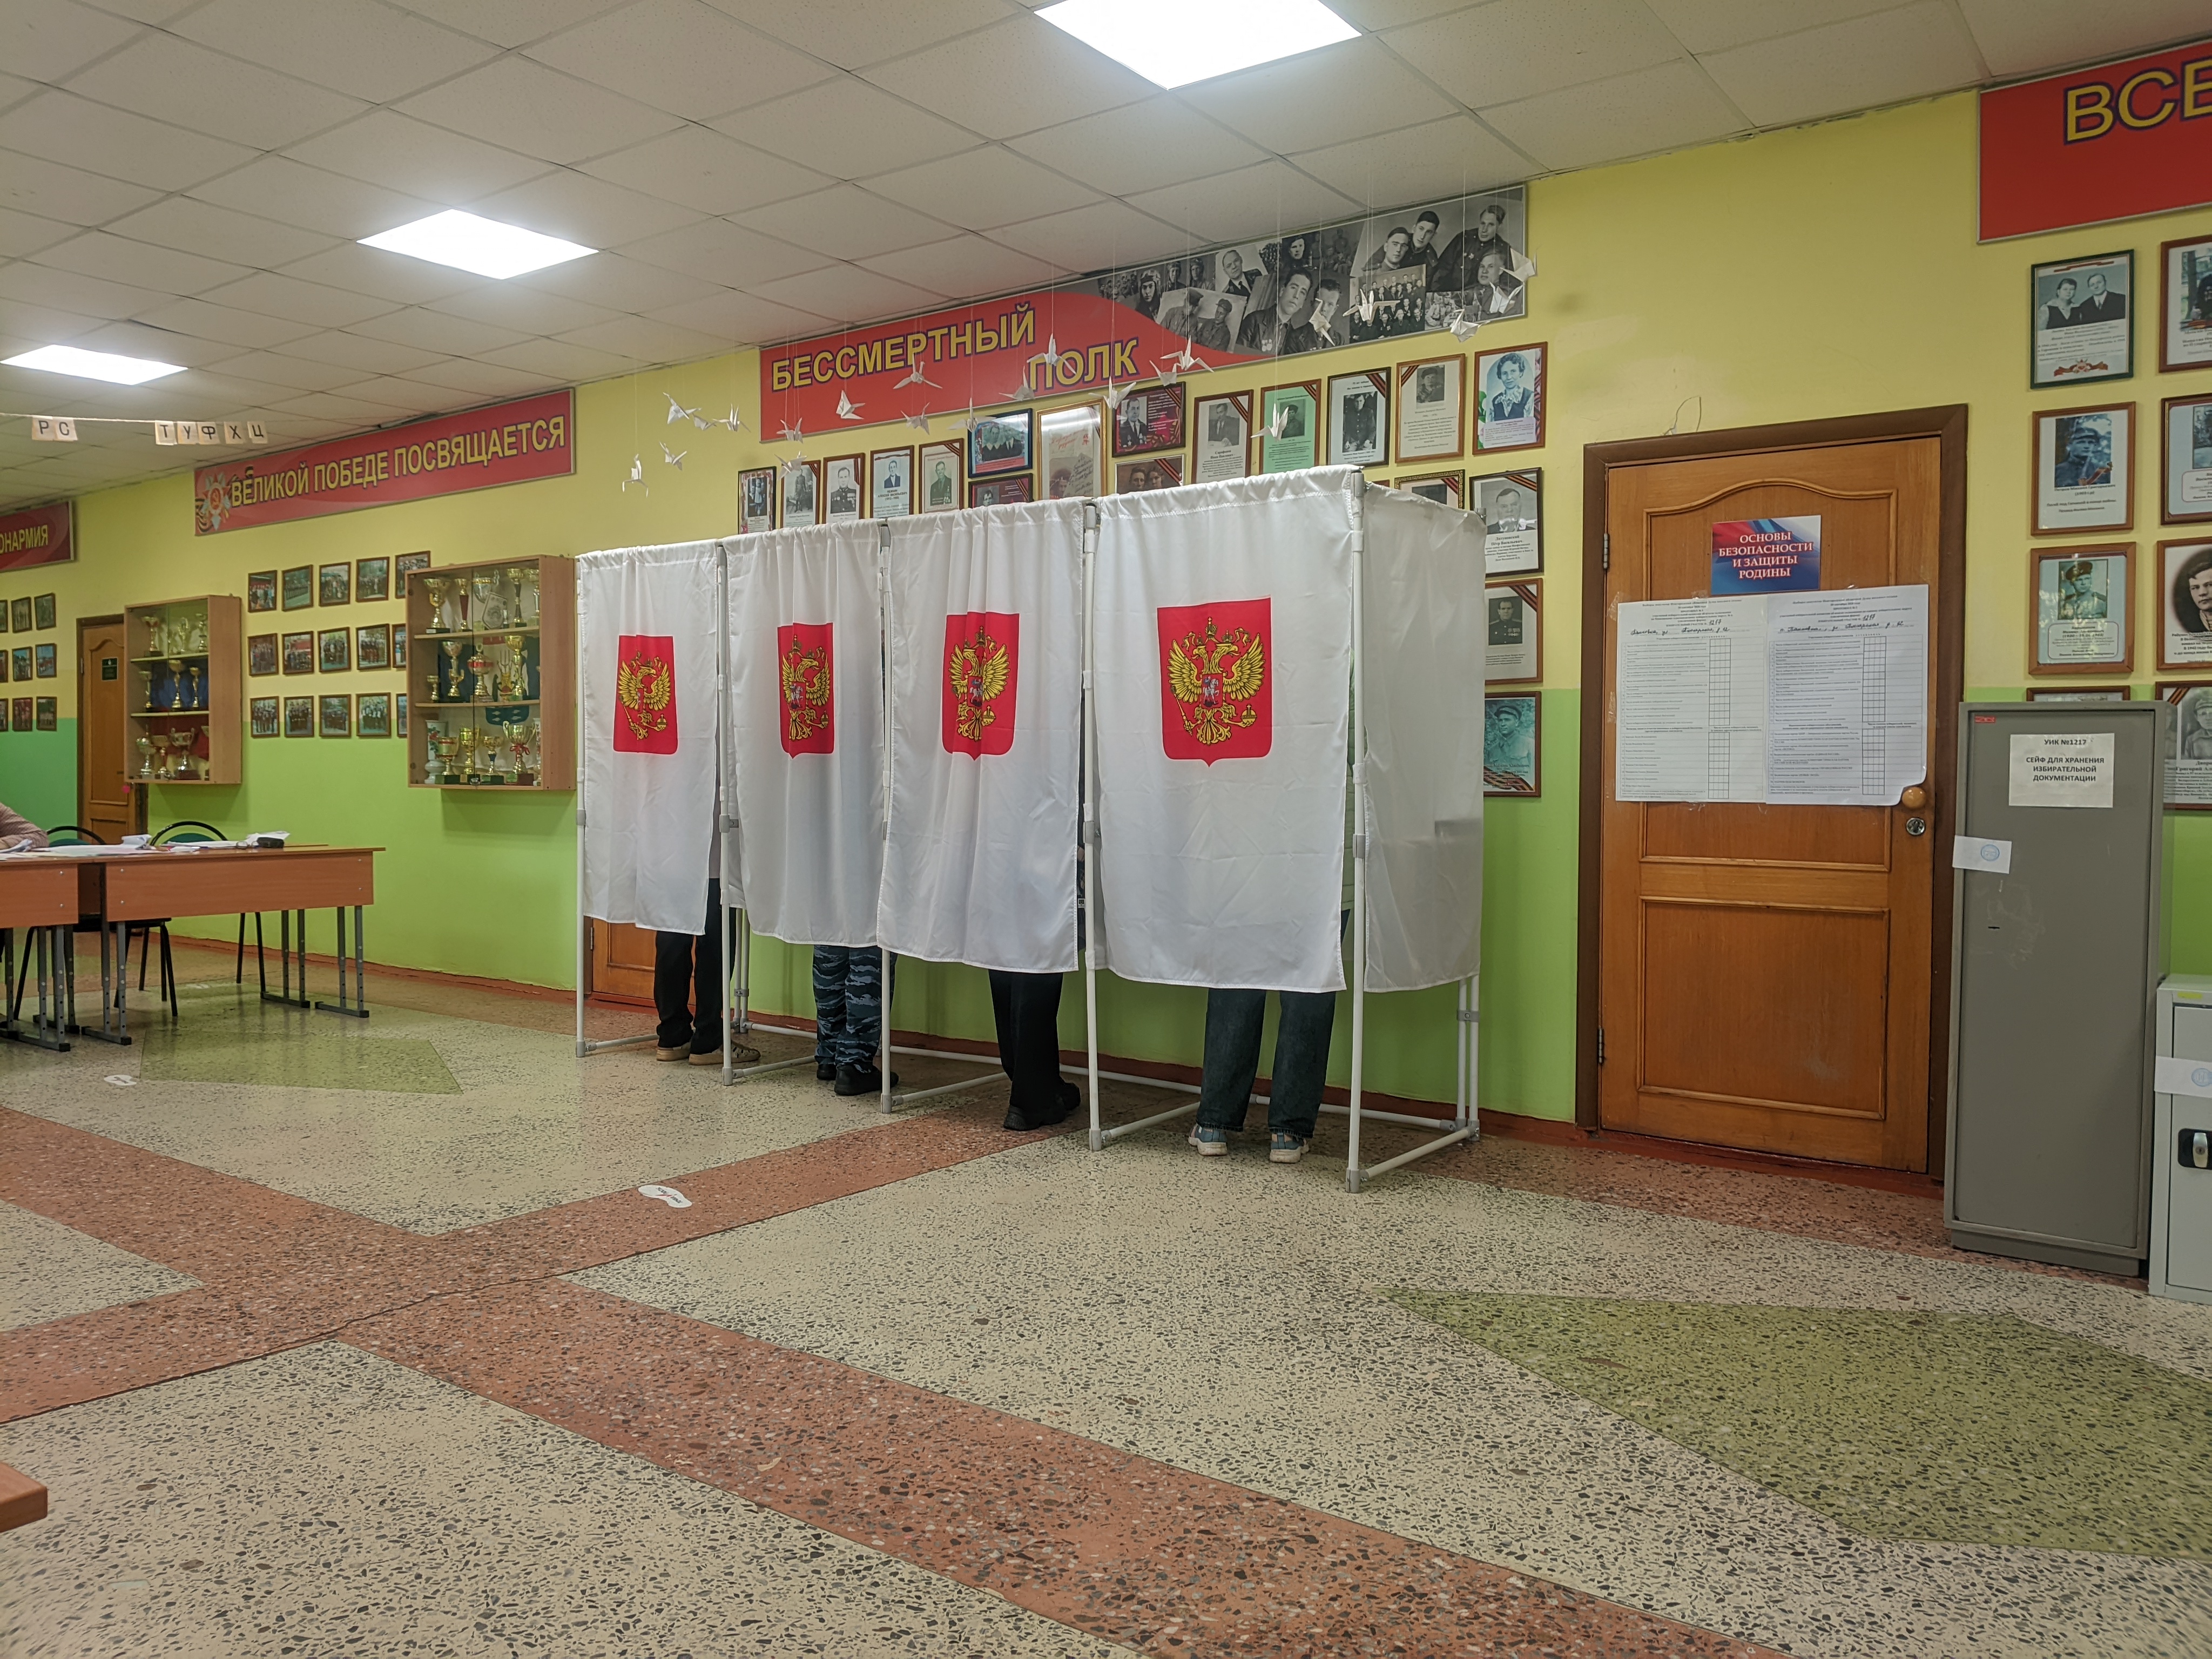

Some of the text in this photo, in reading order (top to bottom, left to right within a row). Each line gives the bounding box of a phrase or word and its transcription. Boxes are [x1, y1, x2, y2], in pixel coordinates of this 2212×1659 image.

[772, 306, 1035, 390] БЕССМЕРТНЫЙ
[1030, 340, 1137, 390] ПОЛК
[231, 416, 565, 507] ВЕЛИКОЙ ПОБЕДЕ ПОСВЯЩАЕТСЯ
[1739, 532, 1792, 543] ОСНОВЫ
[1719, 542, 1813, 557] БЕЗОПАСНОСТИ
[1732, 555, 1798, 568] И ЗАЩИТЫ
[1739, 568, 1791, 579] РОДИНЫ
[2033, 774, 2096, 783] ДОКУМЕНТАЦИИ
